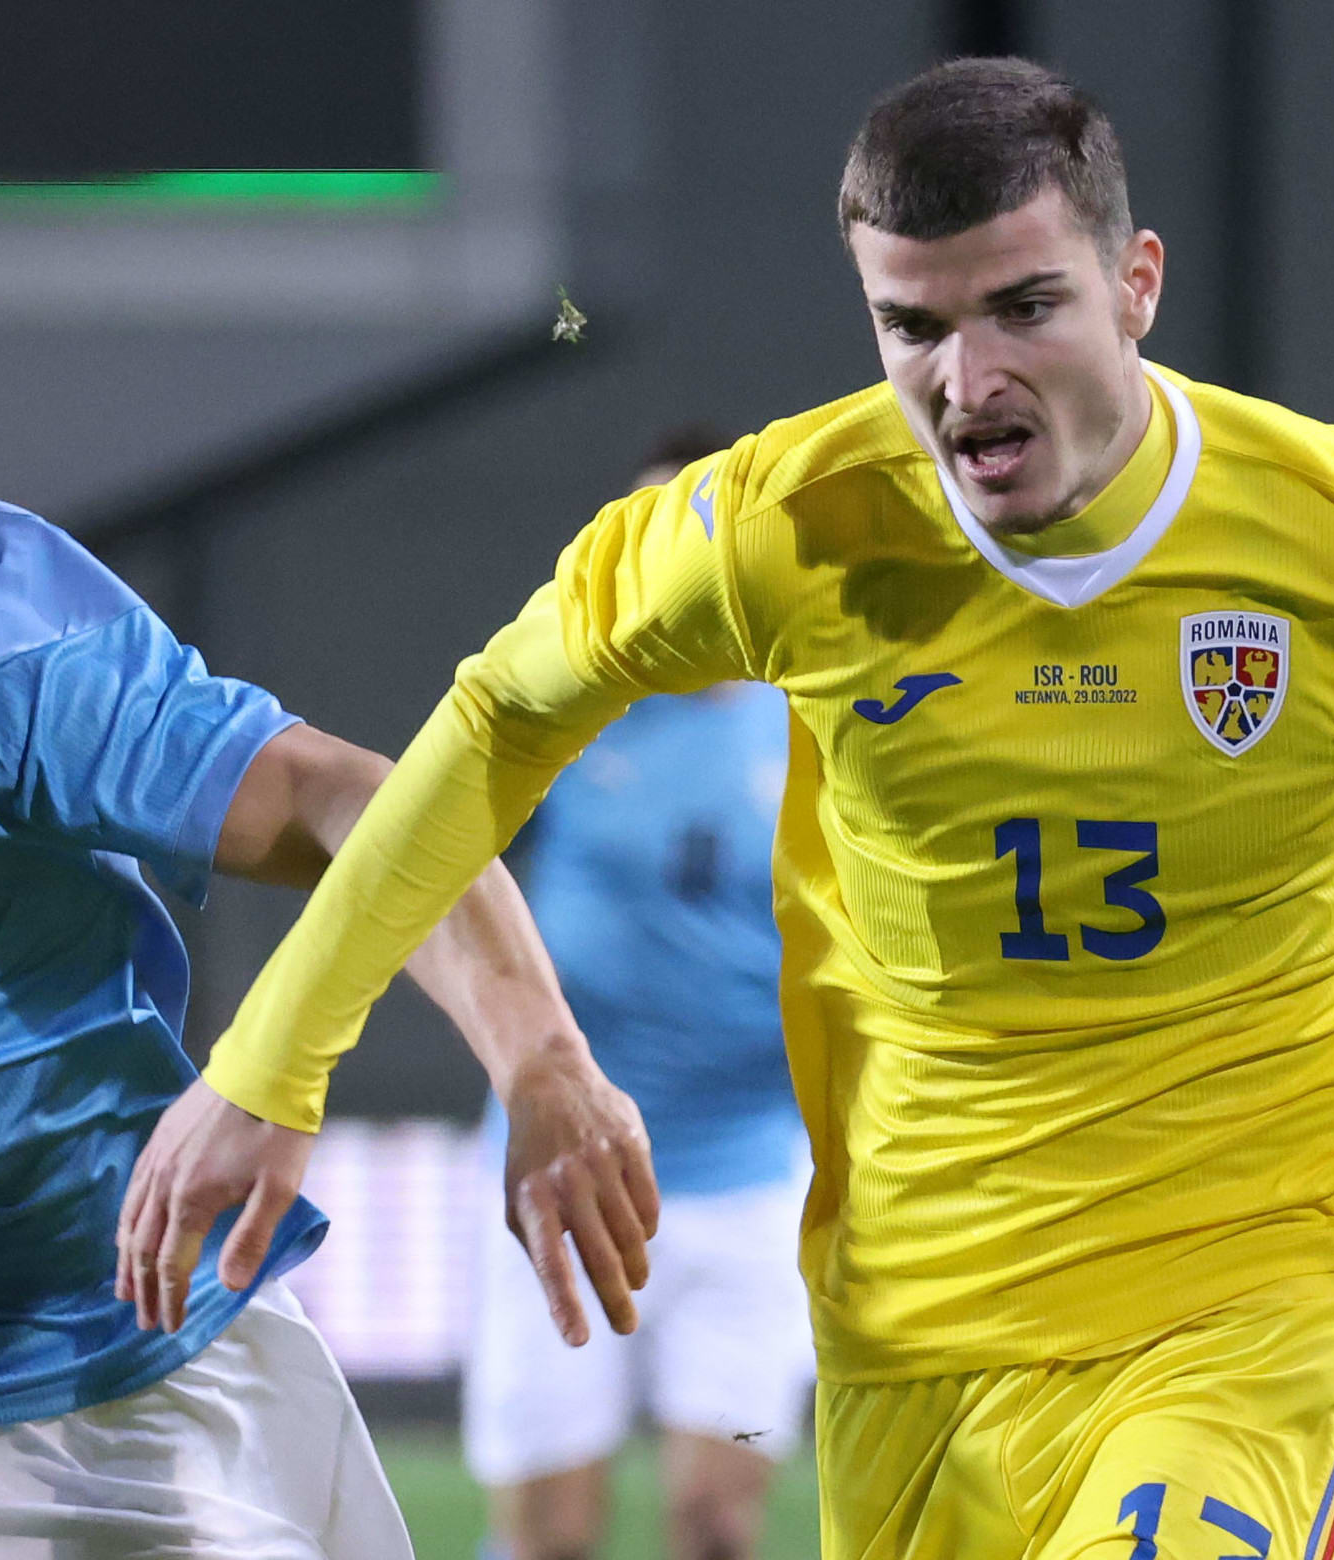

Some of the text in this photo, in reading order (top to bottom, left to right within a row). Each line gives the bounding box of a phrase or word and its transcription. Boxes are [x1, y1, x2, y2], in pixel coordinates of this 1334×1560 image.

[1190, 615, 1280, 645] ROMÂNIA
[1033, 665, 1064, 686] ISR
[1080, 665, 1118, 686] ROU
[1015, 690, 1137, 706] NETANYA, 29.03.2022
[993, 817, 1168, 962] 13
